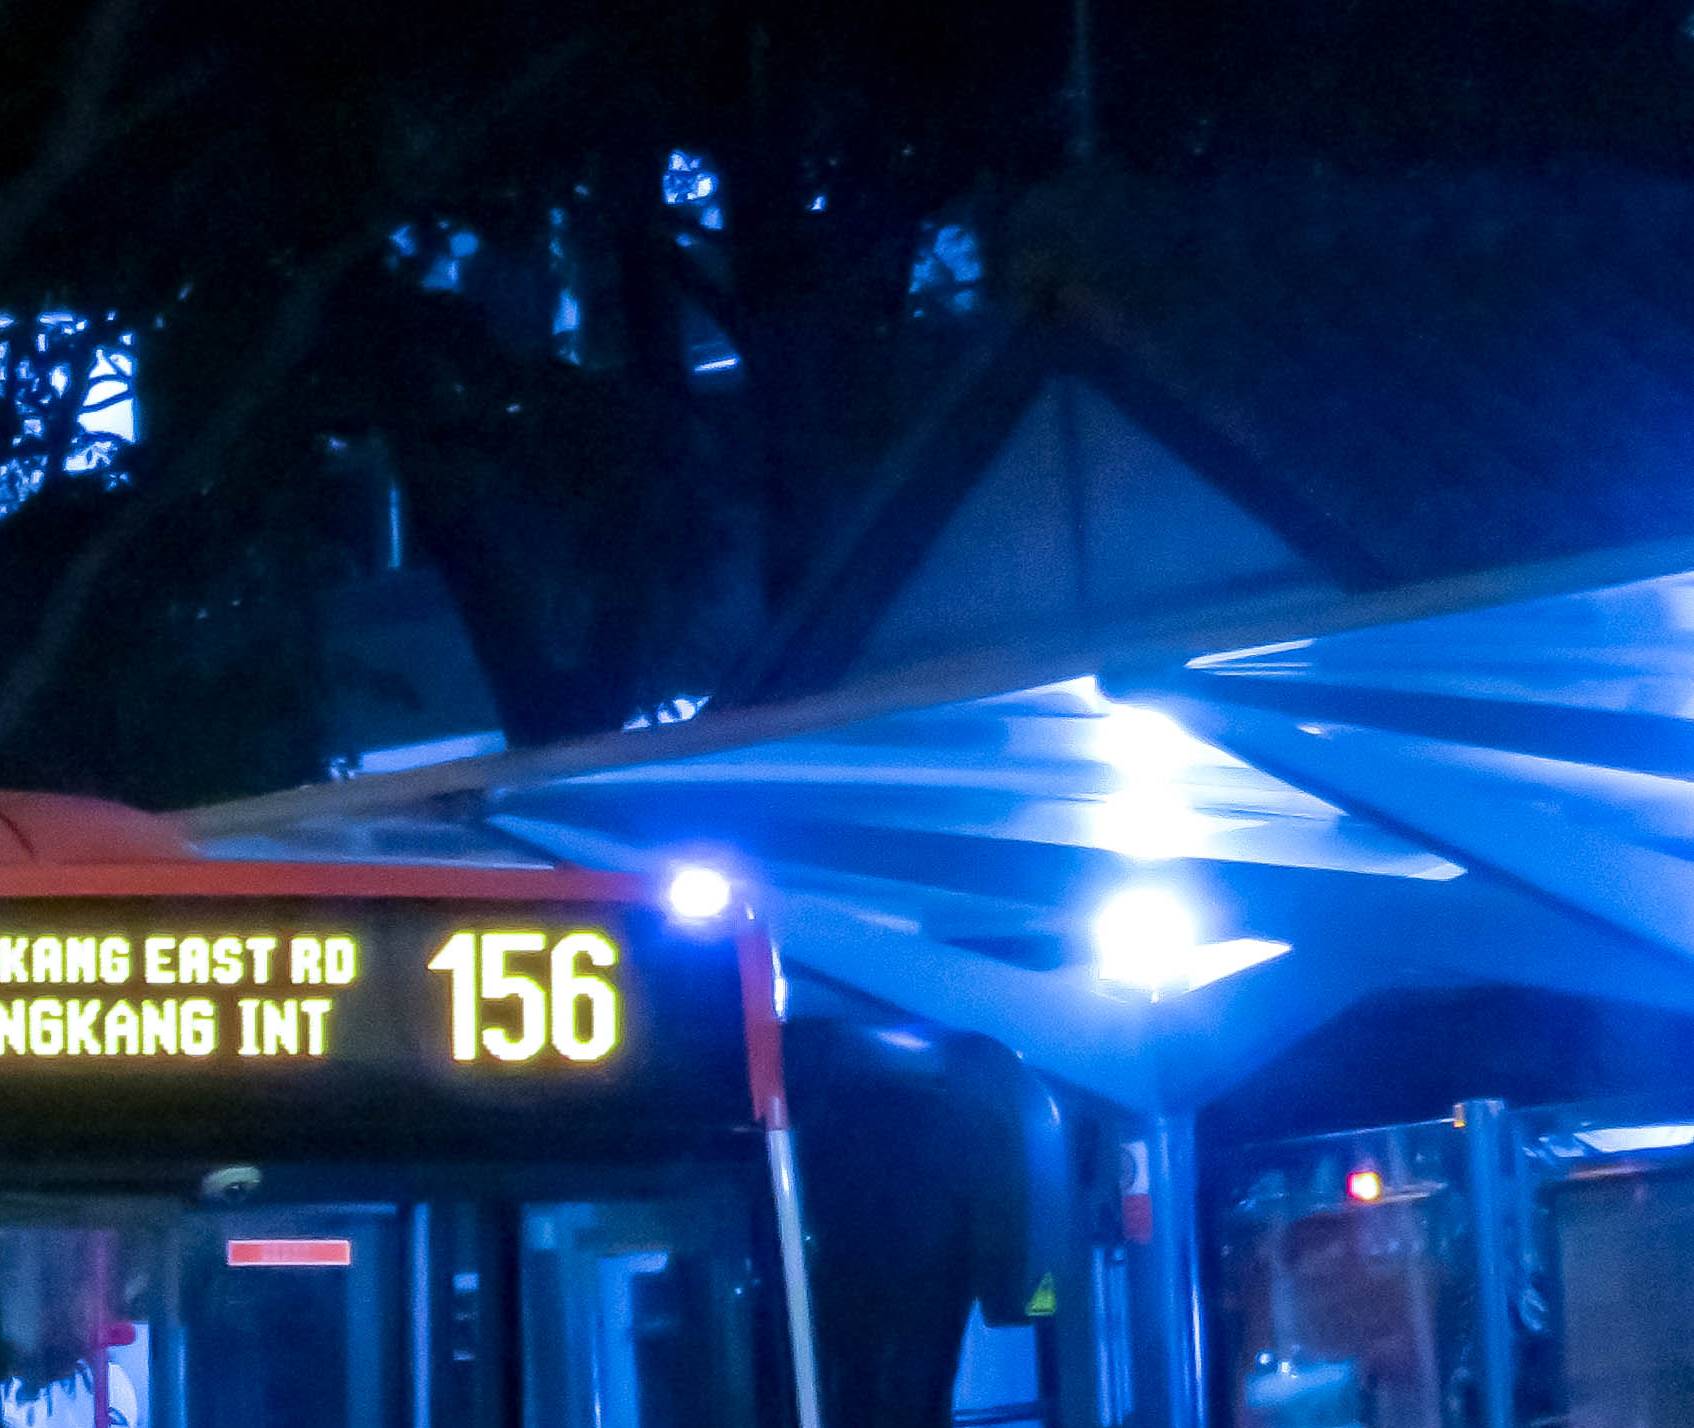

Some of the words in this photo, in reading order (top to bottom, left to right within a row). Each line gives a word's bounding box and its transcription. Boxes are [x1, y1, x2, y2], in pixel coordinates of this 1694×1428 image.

[143, 932, 279, 984] EAST
[288, 932, 358, 984] RD
[427, 929, 622, 1063] 156
[238, 997, 333, 1058] INT
